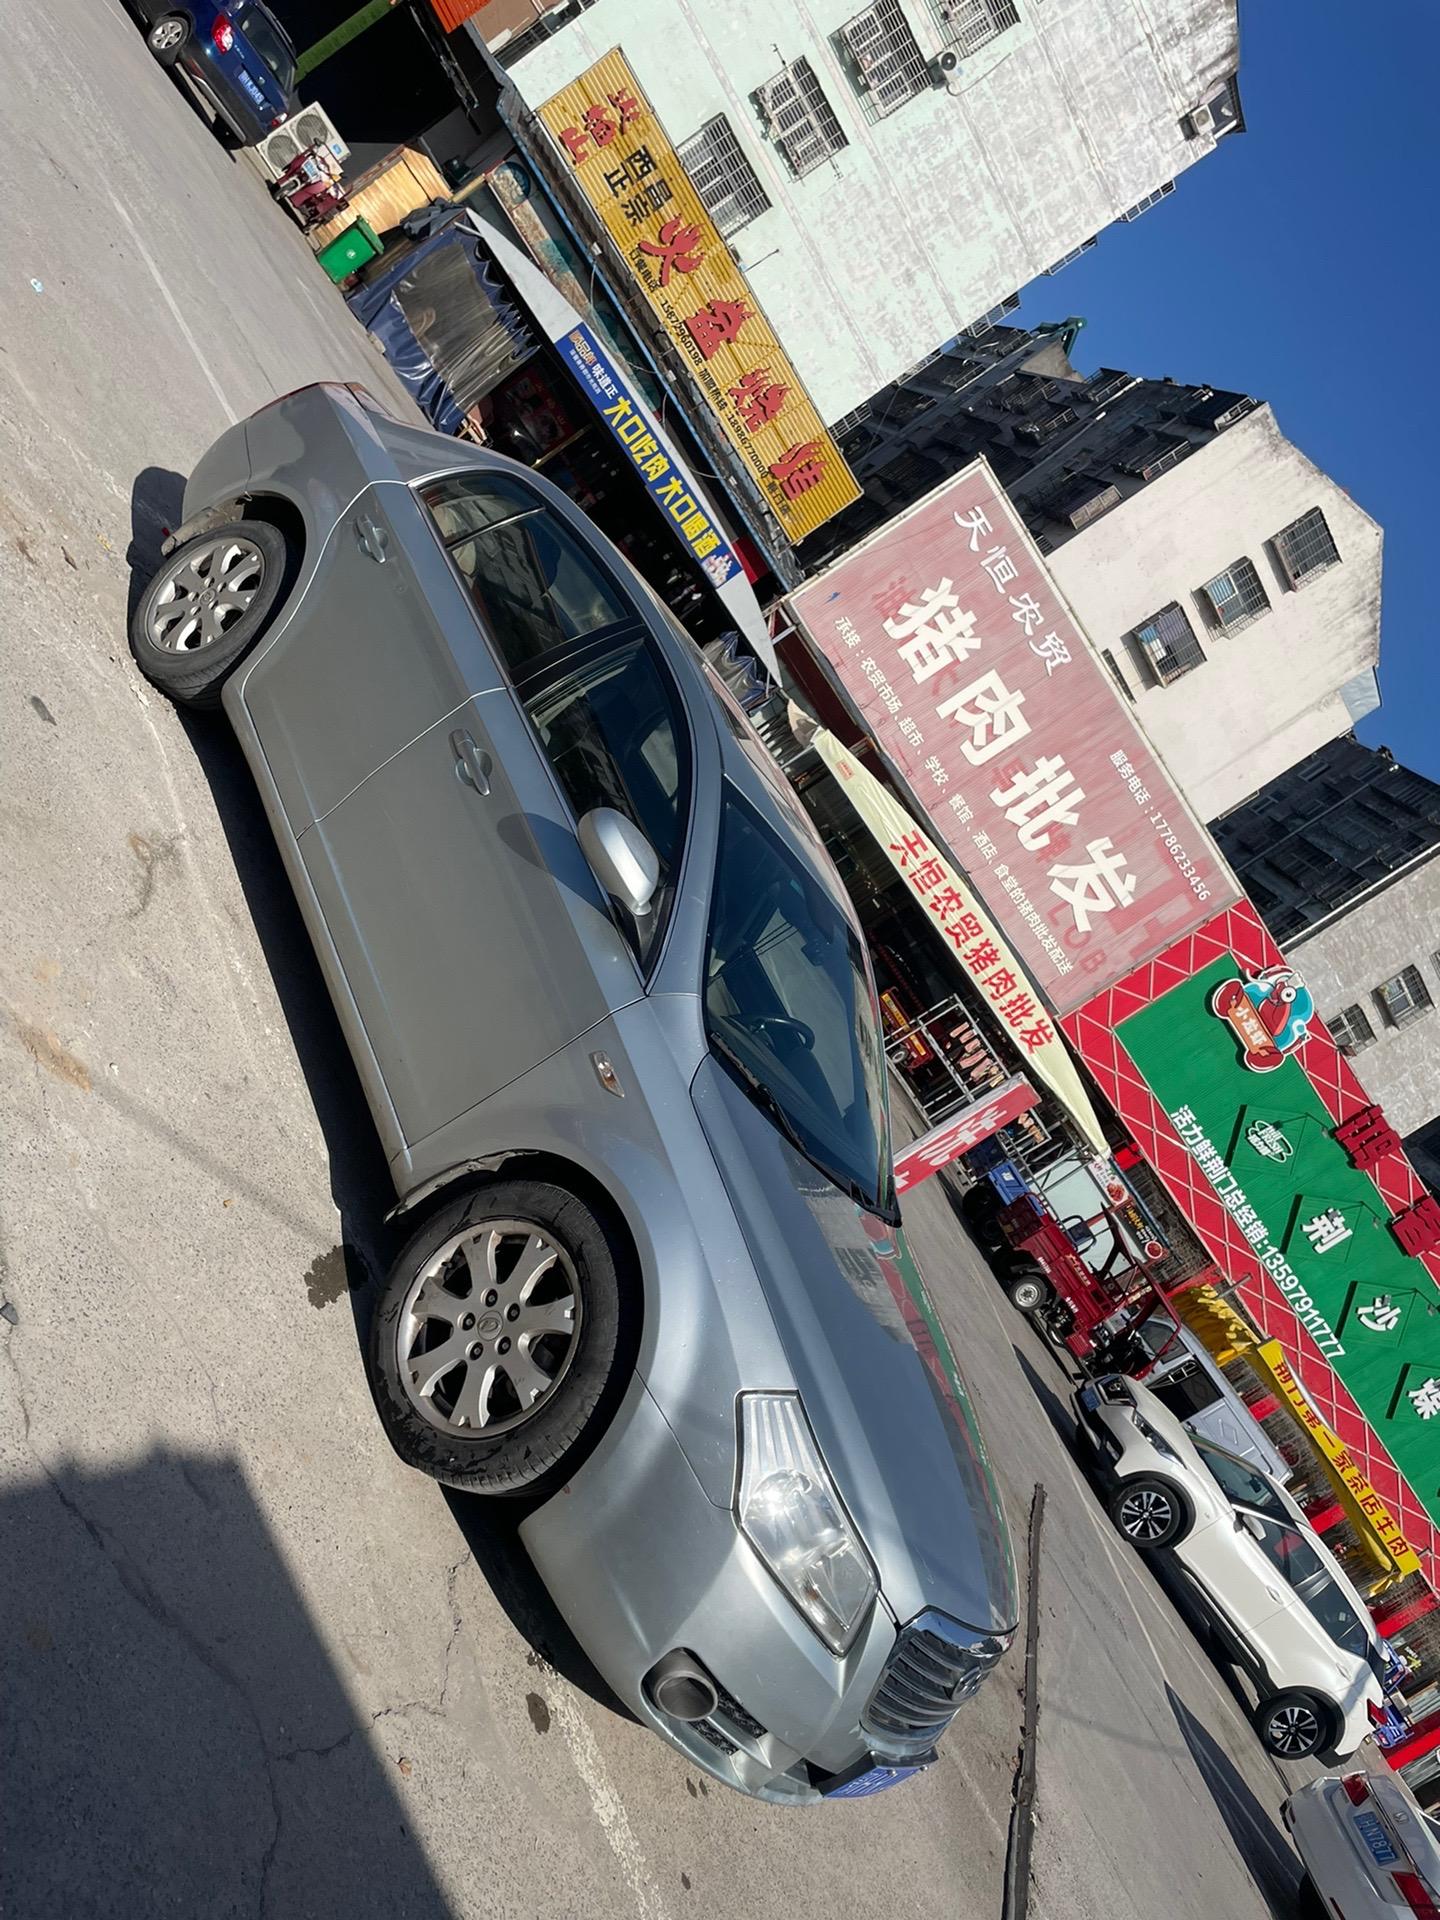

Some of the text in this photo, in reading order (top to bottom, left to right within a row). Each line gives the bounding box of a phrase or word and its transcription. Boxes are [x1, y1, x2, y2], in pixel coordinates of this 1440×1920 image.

[560, 87, 641, 165] 火焰山
[602, 163, 652, 227] 正宗
[624, 144, 673, 212] 西昌
[589, 362, 618, 400] 味道正
[637, 213, 826, 501] 火盆烧烤
[601, 393, 672, 482] 大口吃肉
[654, 473, 722, 559] 大口喝酒
[949, 504, 1072, 676] 天恒农贸
[1108, 748, 1211, 901] 服务电话：17786233456
[877, 574, 1137, 937] 猪肉批发
[887, 827, 1057, 1055] 天恒农贸猪肉批发
[1236, 1006, 1265, 1046] 小龙虾
[1170, 1104, 1345, 1359] 活力鲜荆门总经销:13597911777
[1356, 1813, 1395, 1863] HN7877
